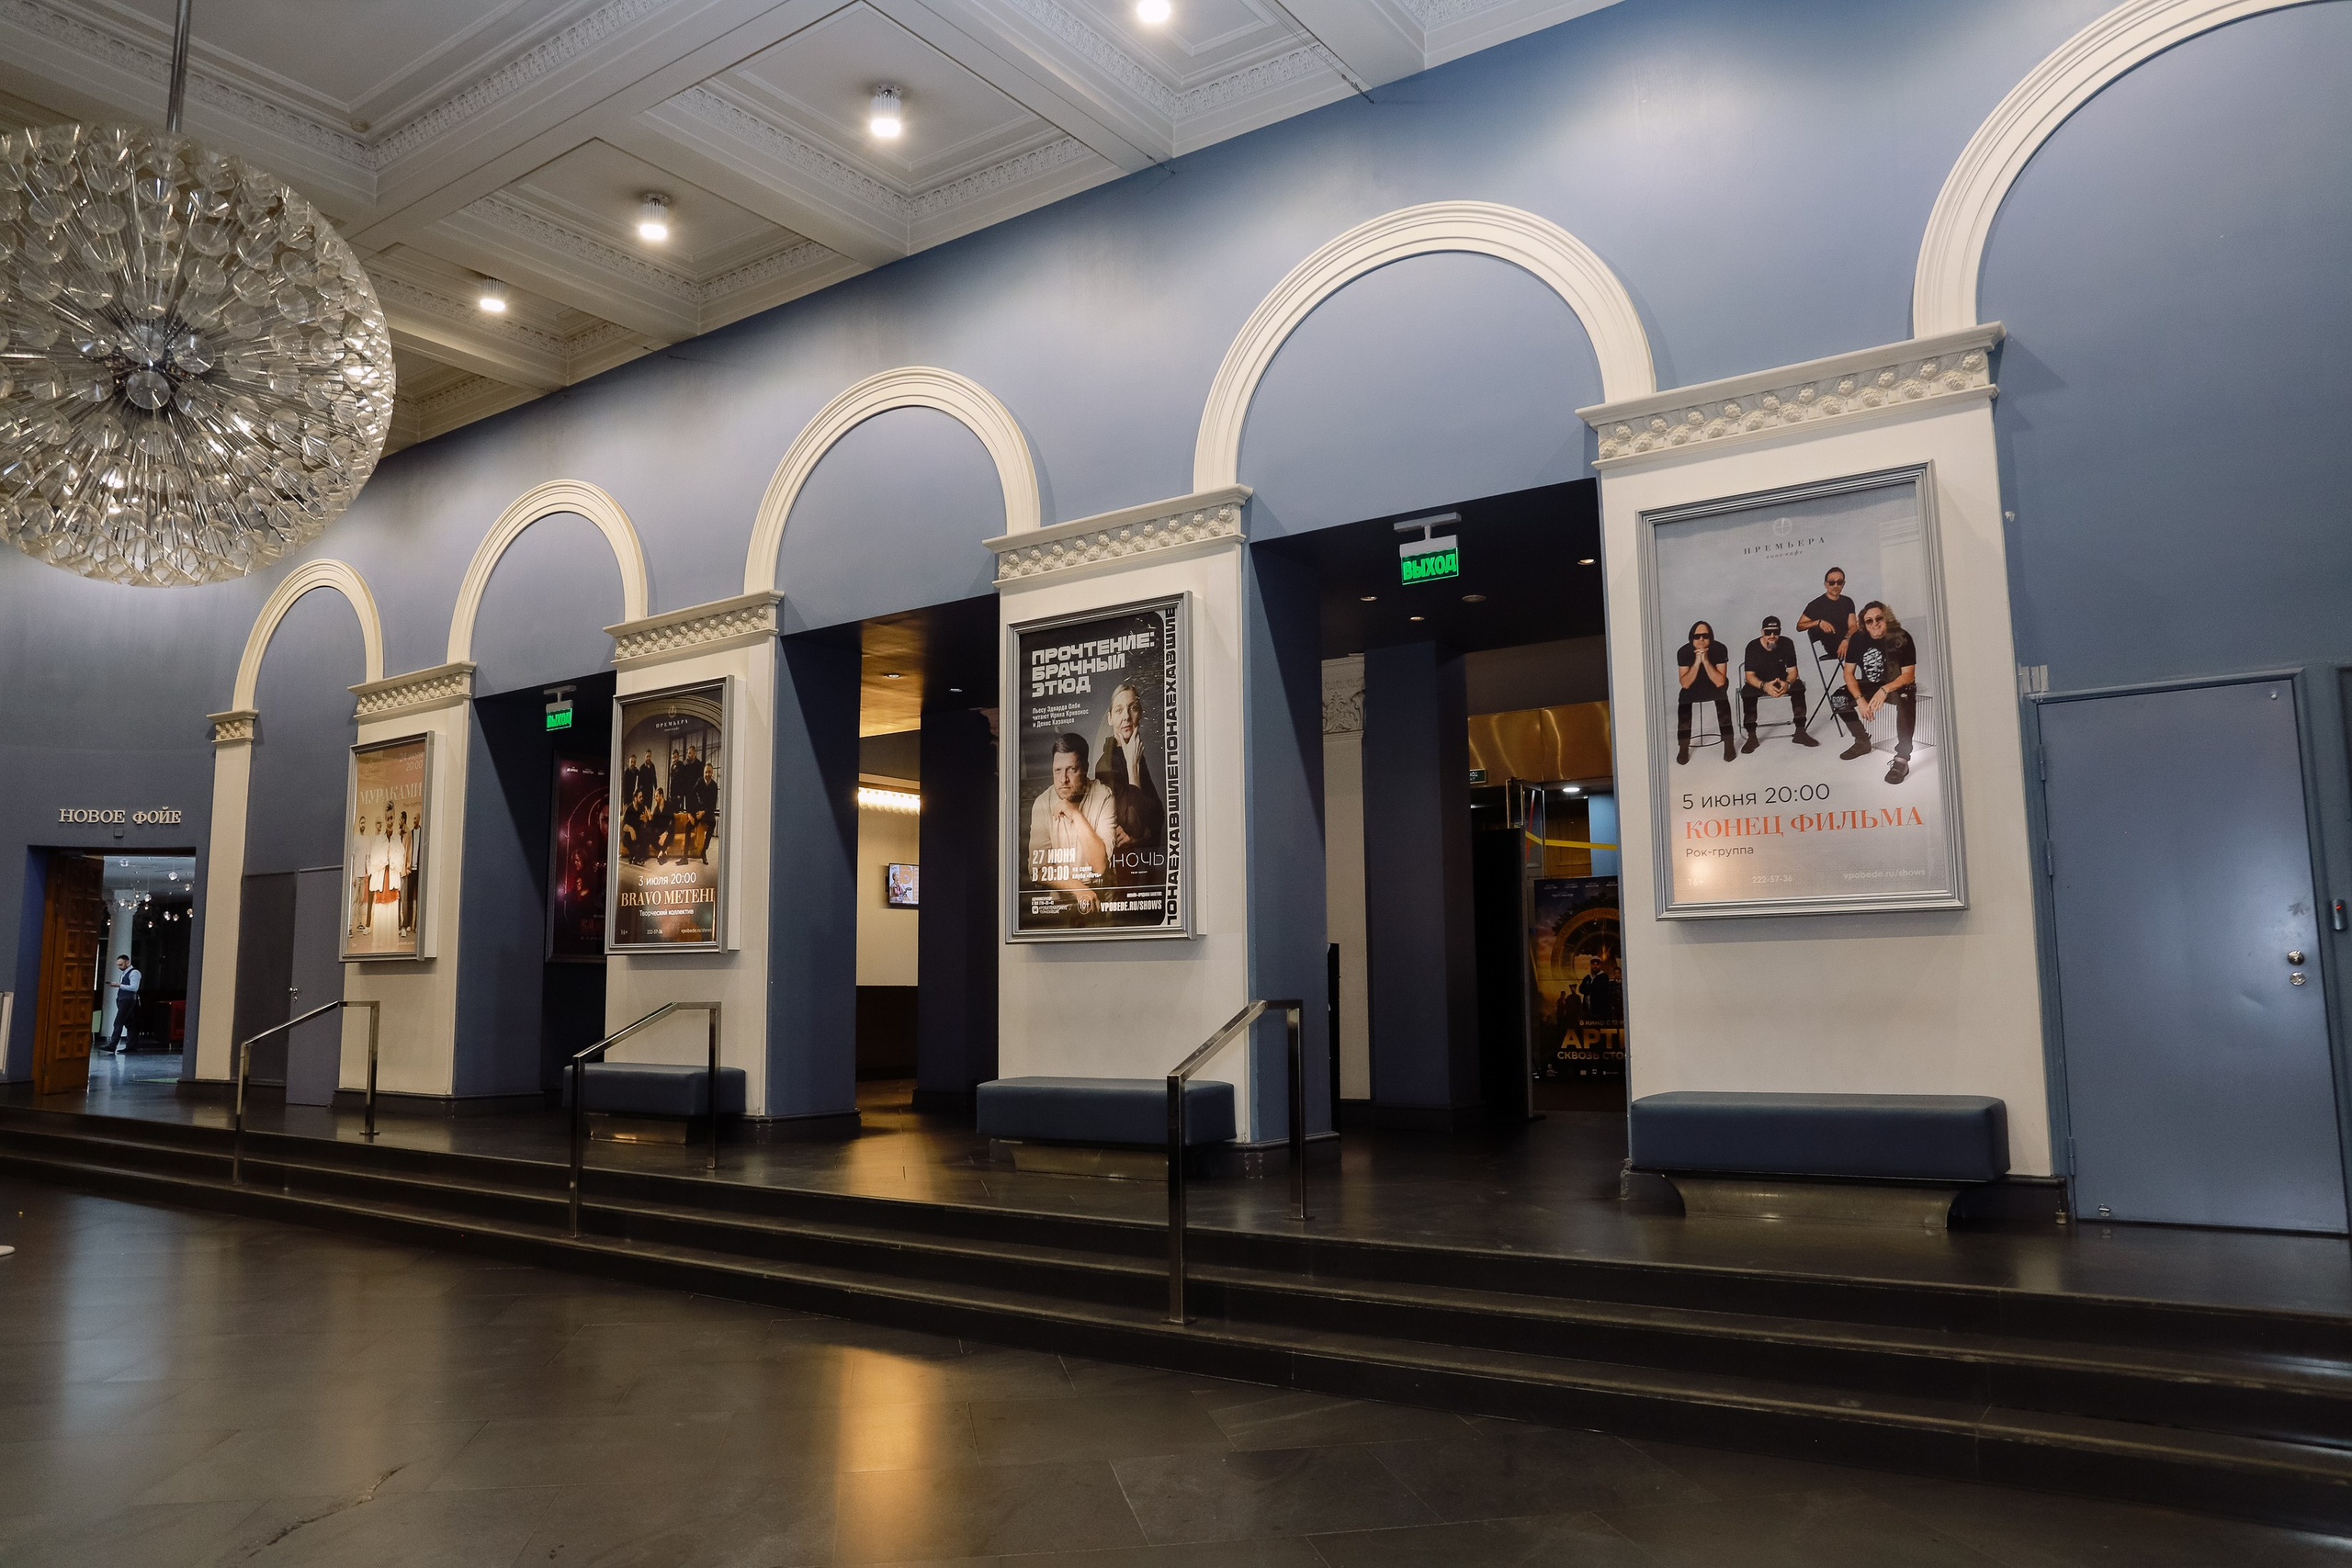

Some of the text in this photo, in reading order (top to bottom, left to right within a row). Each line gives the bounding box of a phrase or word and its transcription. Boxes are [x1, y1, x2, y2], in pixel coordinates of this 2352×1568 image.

[1744, 536, 1825, 555] ПРЕМЬЕРА
[1403, 553, 1457, 581] ВЫХОД
[1032, 631, 1155, 665] ПРОЧТЕНИЕ:
[1032, 652, 1125, 682] БРАЧНЫЙ
[1032, 675, 1091, 698] ЭТЮД
[1047, 705, 1068, 713] Эдварда
[1068, 702, 1081, 710] Олби
[547, 711, 571, 728] ВЫХОД
[1036, 720, 1052, 728] Денис
[1052, 717, 1075, 726] Казанцев
[360, 782, 423, 805] МУРАКАМИ
[1682, 783, 1830, 810] 5 июня 20:00
[59, 806, 182, 825] НОВОЕ ФОЙЕ
[1685, 806, 1925, 840] КОНЕЦ ФИЛЬМА
[1032, 848, 1076, 864] 27 ИЮНЯ
[1113, 852, 1165, 868] НОЧЬ
[1686, 846, 1754, 858] Рок-группа
[639, 872, 697, 886] 3 июля 20:00
[1032, 865, 1069, 882] В 20:00
[1752, 874, 1792, 884] 222-57-36
[1843, 868, 1926, 880] vpobede.ru/shows
[620, 887, 715, 907] BRAVO METEHI
[1080, 899, 1091, 909] 16+
[639, 908, 668, 918] Творческий
[1100, 899, 1162, 913] VPOBEDE.RU/SHOWS
[1556, 1051, 1600, 1060] СКВОЗЬ
